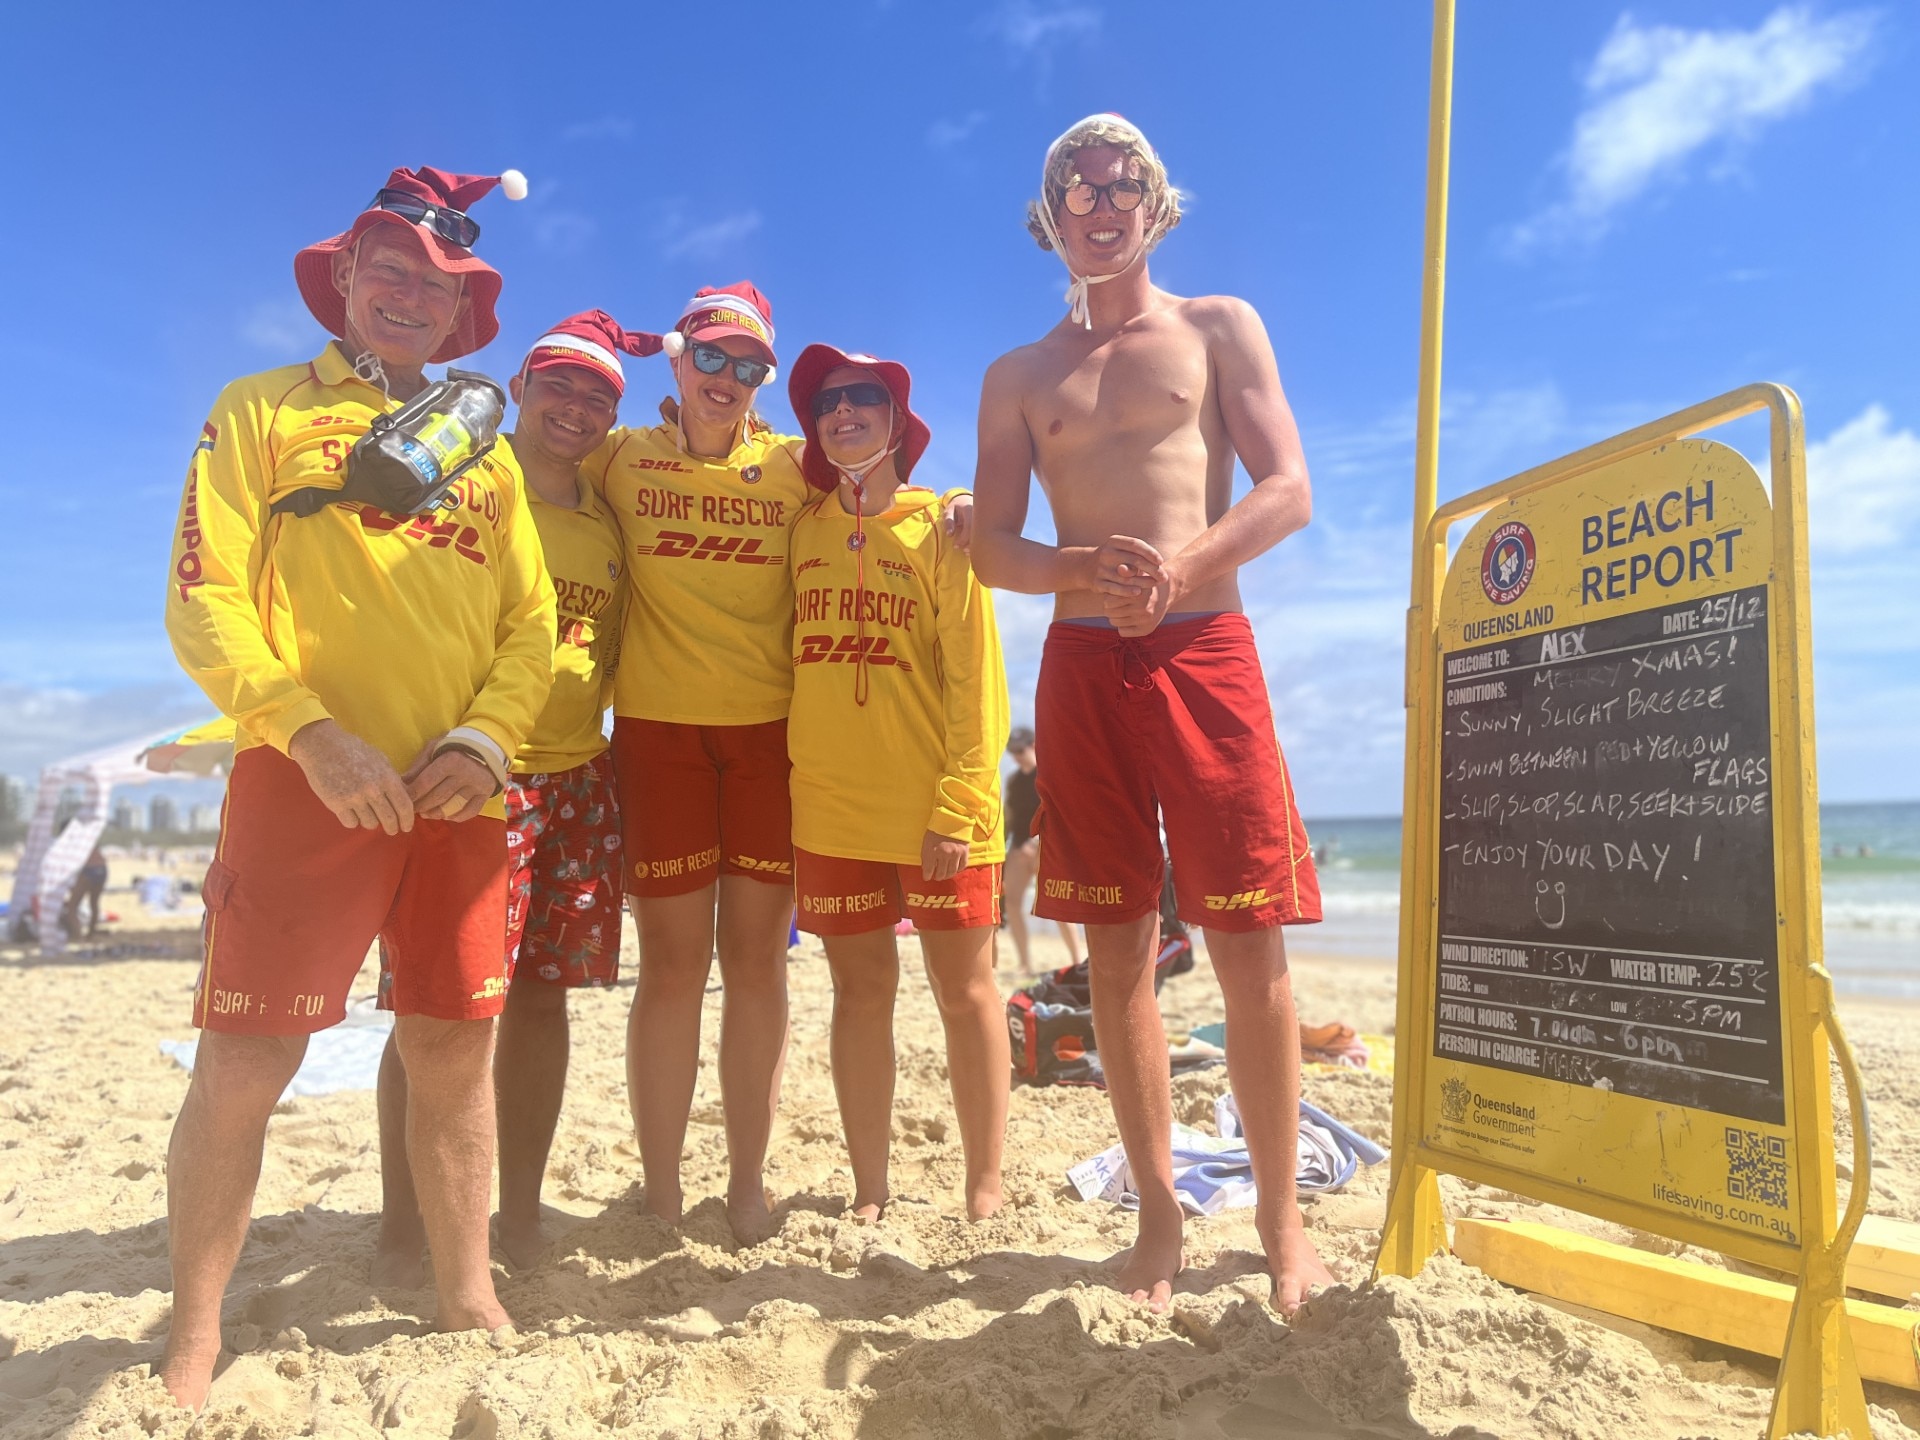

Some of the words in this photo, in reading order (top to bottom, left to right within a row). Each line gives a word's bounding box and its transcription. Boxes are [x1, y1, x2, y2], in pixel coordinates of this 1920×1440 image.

[710, 309, 737, 323] SURF
[636, 458, 686, 473] DHL
[636, 488, 694, 520] SURF
[702, 496, 785, 527] RESCUE
[1582, 479, 1714, 555] BEACH
[651, 530, 771, 565] DHL
[1495, 525, 1525, 543] SURF
[796, 557, 824, 579] DHL
[877, 558, 918, 577] ISUZ
[884, 569, 911, 581] UTE
[1582, 527, 1743, 605] REPORT
[1482, 571, 1499, 600] LIFE
[1500, 559, 1534, 602] SAVING
[838, 588, 918, 632] RESCUE
[1463, 605, 1554, 642] QUEENSLAND
[1662, 609, 1700, 635] DATE:
[1700, 593, 1766, 629] 25/12
[800, 634, 898, 666] DHL
[1540, 626, 1587, 664] ALEX
[1631, 635, 1738, 679] XMAS!
[1447, 654, 1491, 676] WELCOME
[1493, 648, 1510, 668] TO:
[1446, 681, 1507, 707] CONDITIONS:
[1541, 697, 1620, 728] SLIGHT
[1508, 746, 1587, 775] BETWEEN
[1646, 731, 1730, 762] YELLOW
[1692, 756, 1768, 789] FLAGS
[651, 858, 684, 879] SURF
[738, 854, 792, 875] DHL
[1536, 838, 1596, 872] YOUR
[812, 896, 843, 914] SURF
[846, 888, 887, 913] RESCUE
[907, 892, 957, 909] DHL
[1044, 879, 1075, 900] SURF
[1077, 884, 1123, 905] RESCUE
[1204, 889, 1270, 911] DHL
[1441, 943, 1469, 962] WIND
[1470, 945, 1529, 969] DIRECTION:
[1440, 972, 1471, 992] TIDES:
[1473, 983, 1489, 995] HIGH
[1609, 958, 1657, 983] WATER
[1658, 962, 1702, 987] TEMP:
[483, 976, 504, 998] DH
[212, 989, 253, 1015] SURF
[1610, 1000, 1628, 1014] LOW
[1439, 1002, 1476, 1025] PATROL
[1477, 1007, 1518, 1032] HOURS:
[1438, 1032, 1479, 1057] PERSON
[1479, 1040, 1491, 1059] IN
[1492, 1042, 1541, 1068] CHARGE:
[1473, 1093, 1536, 1121] Queensland
[1472, 1109, 1536, 1139] Government
[1652, 1182, 1793, 1236] lifesaving.com.au
